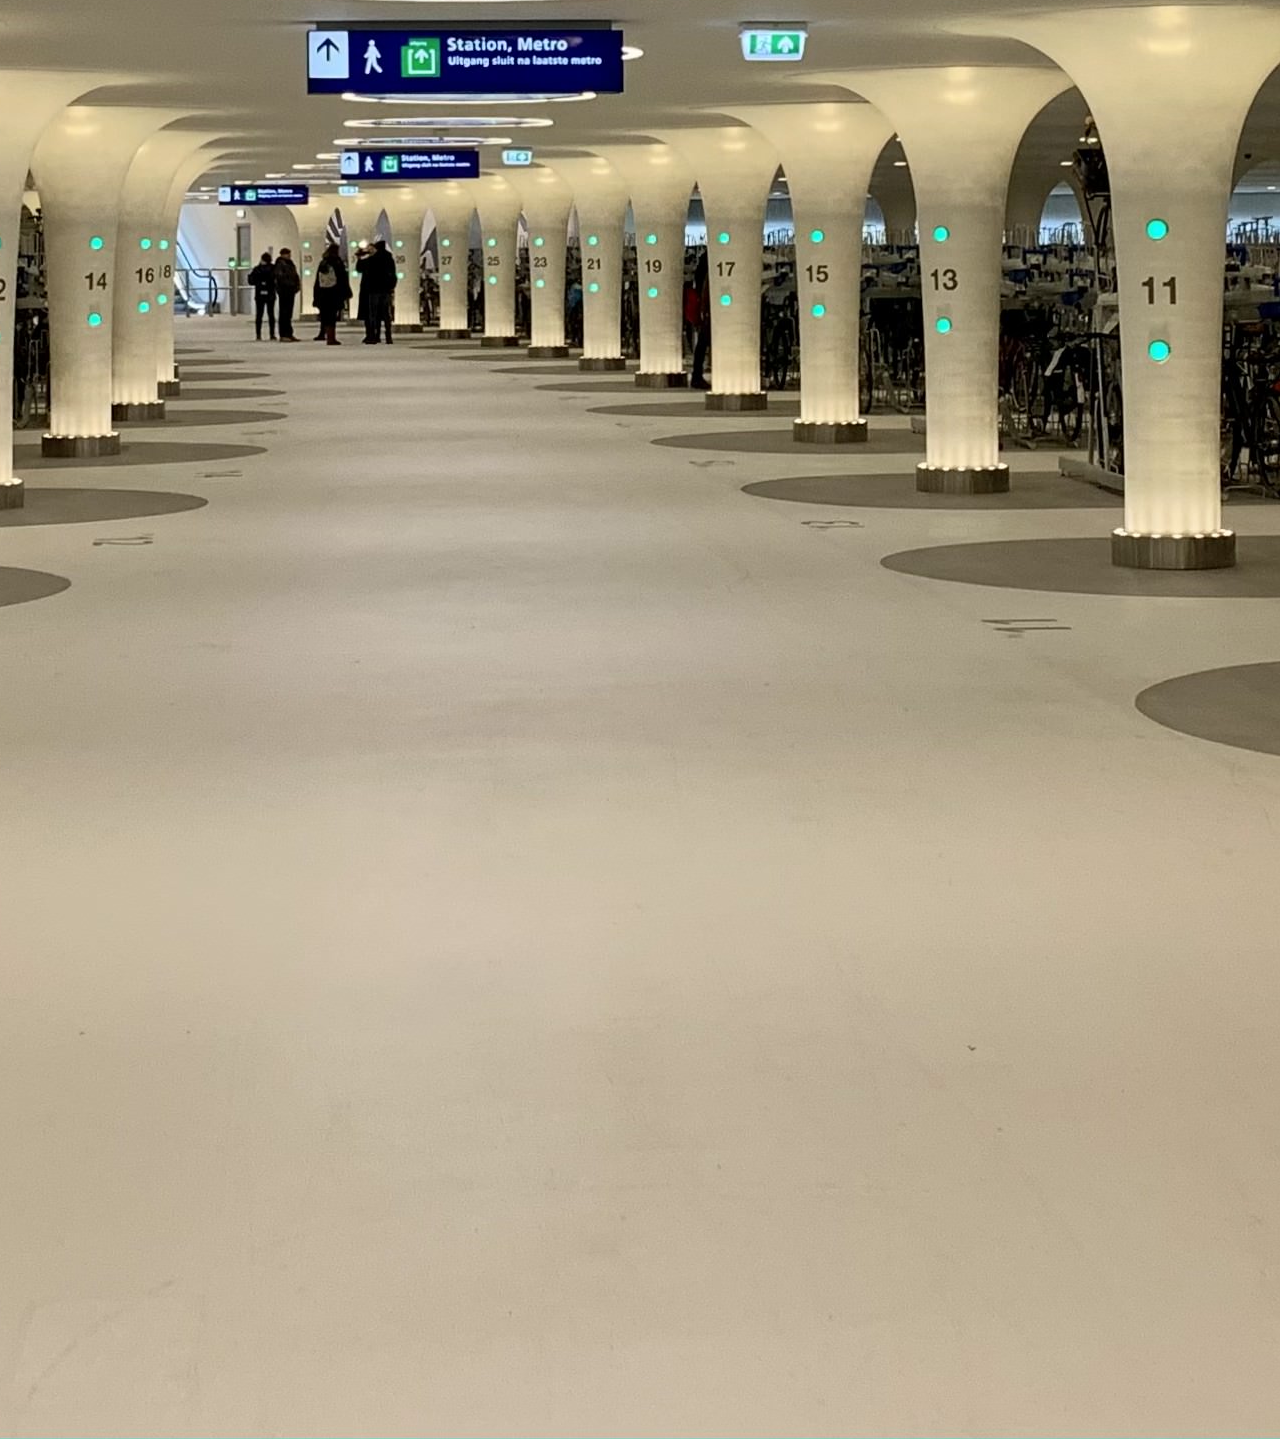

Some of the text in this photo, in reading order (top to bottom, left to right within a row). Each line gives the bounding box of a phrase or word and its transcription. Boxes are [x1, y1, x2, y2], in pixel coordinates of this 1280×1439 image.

[447, 37, 568, 53] Station, Metro
[448, 56, 489, 68] Uitgang
[492, 55, 515, 65] sluit
[518, 57, 531, 65] na
[571, 56, 603, 65] metro
[441, 256, 453, 265] 27
[487, 256, 501, 266] 25
[533, 257, 548, 267] 23
[587, 259, 602, 270] 21
[644, 260, 662, 274] 19
[135, 267, 155, 284] 16
[716, 262, 736, 277] 17
[805, 265, 829, 283] 15
[84, 272, 107, 291] 14
[930, 269, 958, 291] 13
[1141, 276, 1177, 305] 11
